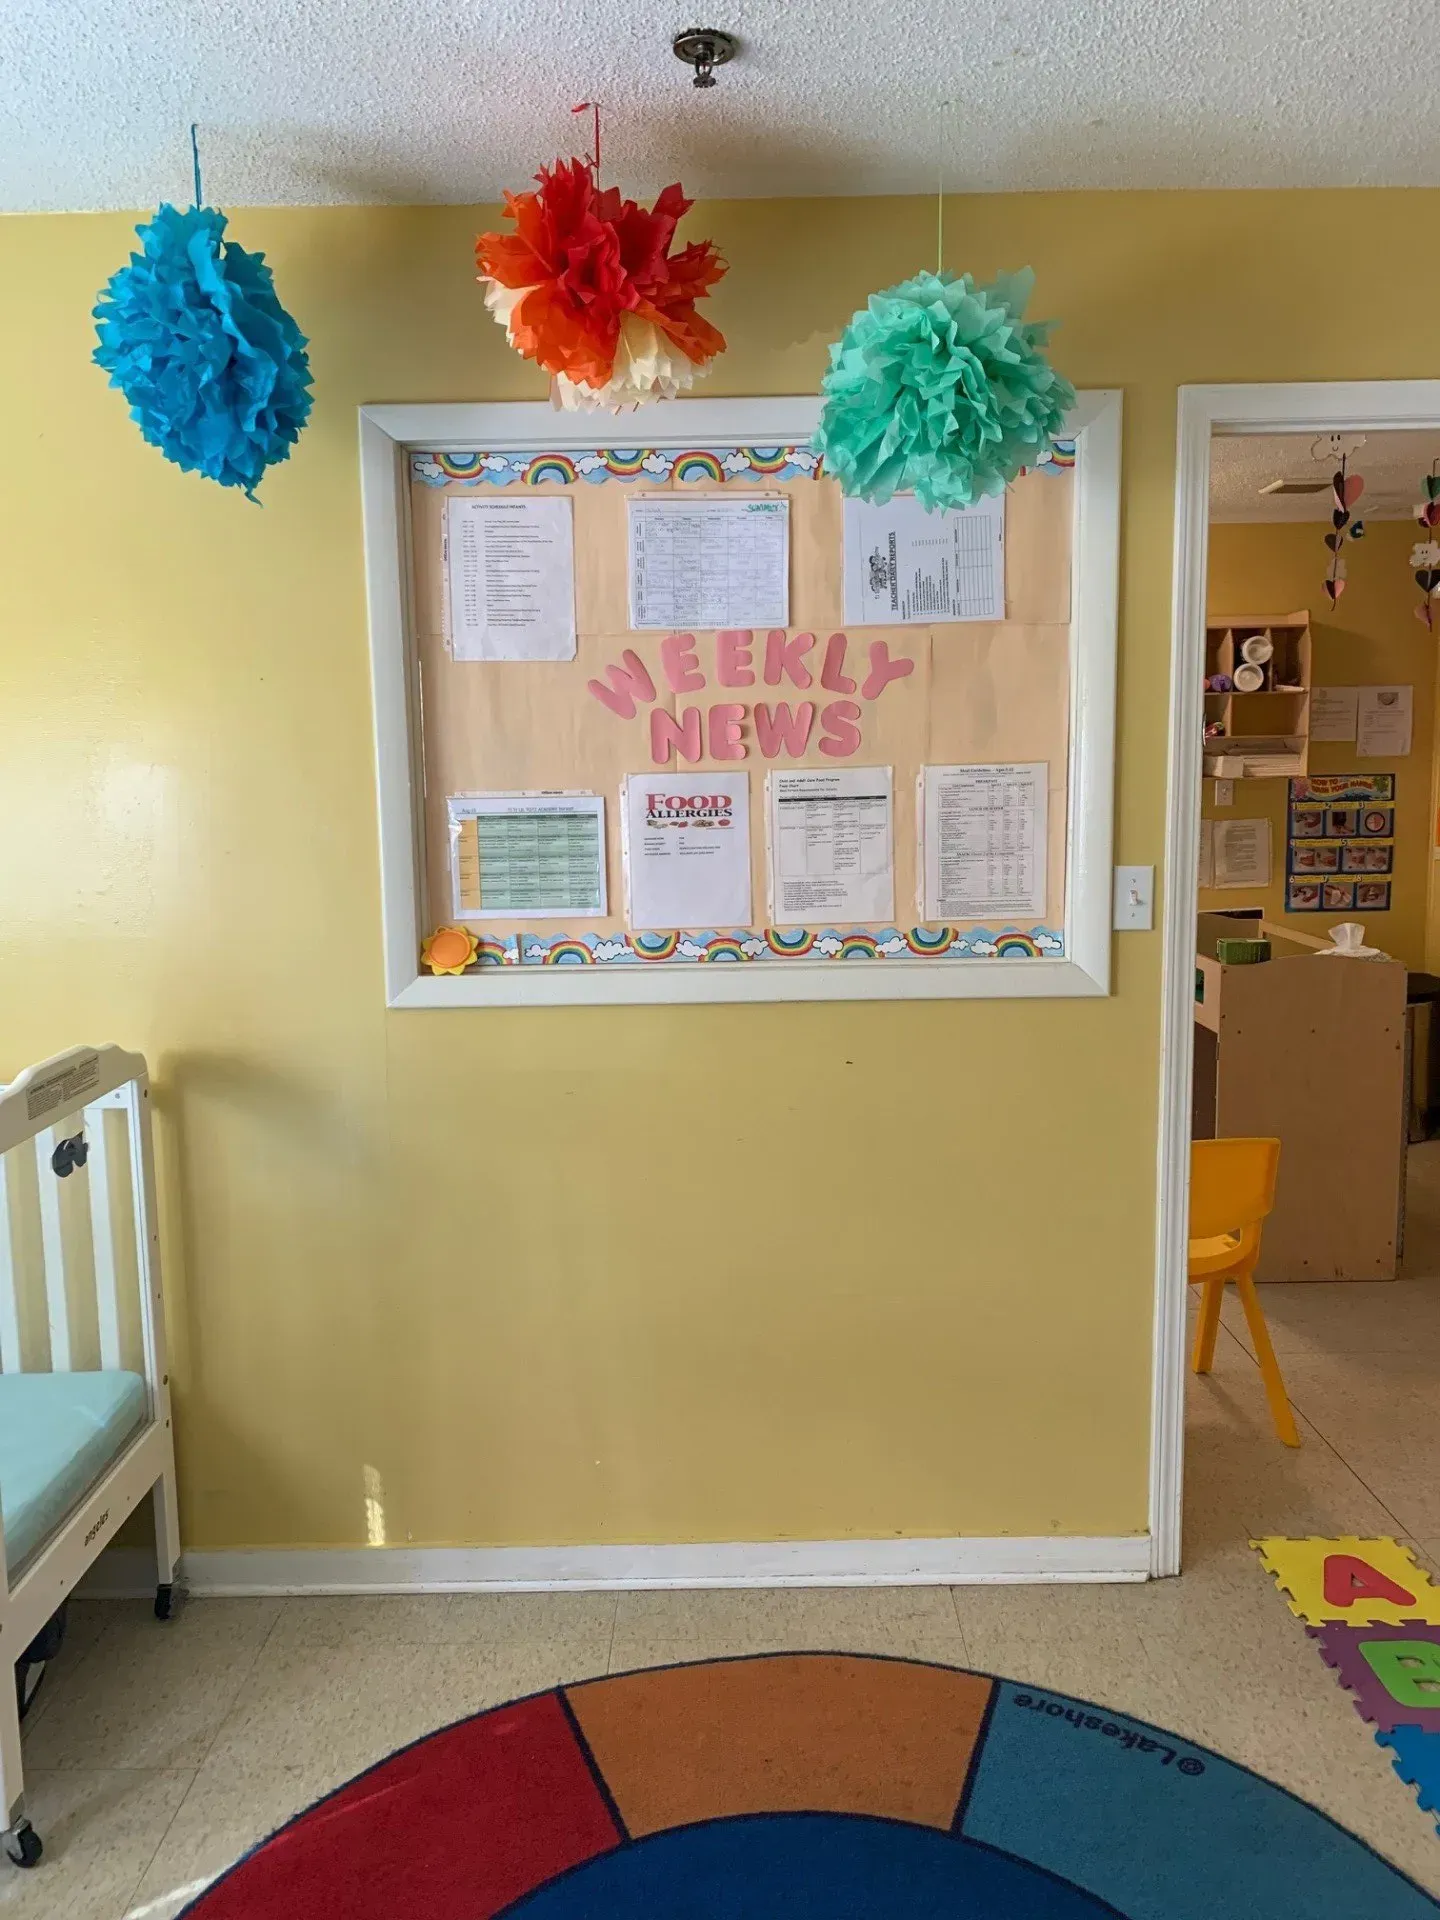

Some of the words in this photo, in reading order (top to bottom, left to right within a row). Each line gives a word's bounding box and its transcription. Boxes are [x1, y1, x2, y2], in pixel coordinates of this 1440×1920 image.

[890, 583, 898, 611] TEACHER
[587, 629, 915, 720] WEEKLY
[650, 700, 861, 764] NEWS
[645, 793, 732, 810] FOOD
[1331, 783, 1348, 792] YOUR
[645, 809, 733, 819] ALLERGIES
[1323, 1554, 1417, 1608] A
[1358, 1640, 1440, 1709] B
